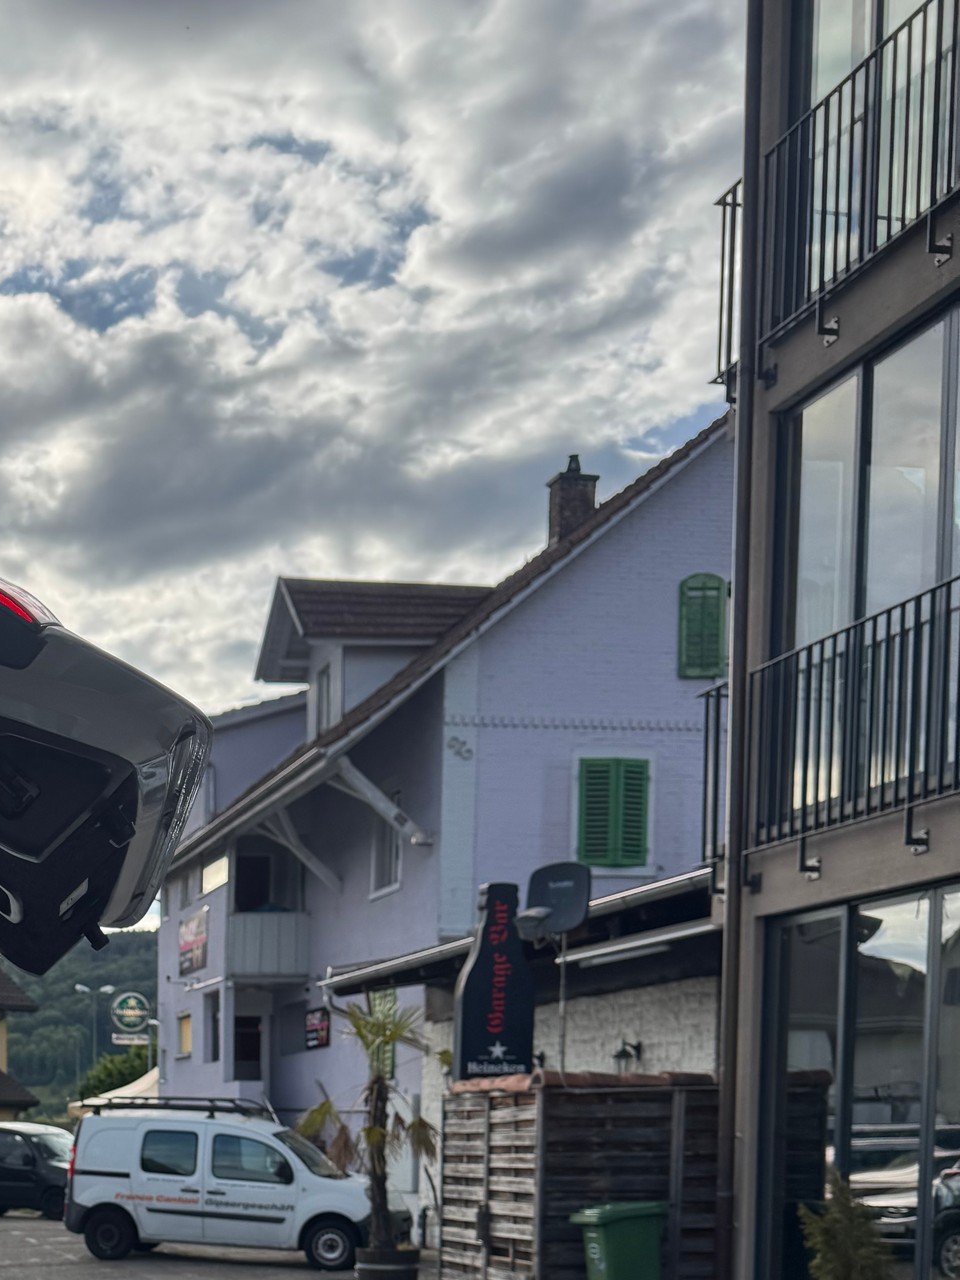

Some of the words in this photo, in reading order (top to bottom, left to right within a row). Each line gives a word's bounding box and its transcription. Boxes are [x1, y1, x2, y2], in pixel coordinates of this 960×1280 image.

[488, 901, 509, 945] Bar
[486, 953, 512, 1034] Garage
[467, 1061, 526, 1075] Heineken
